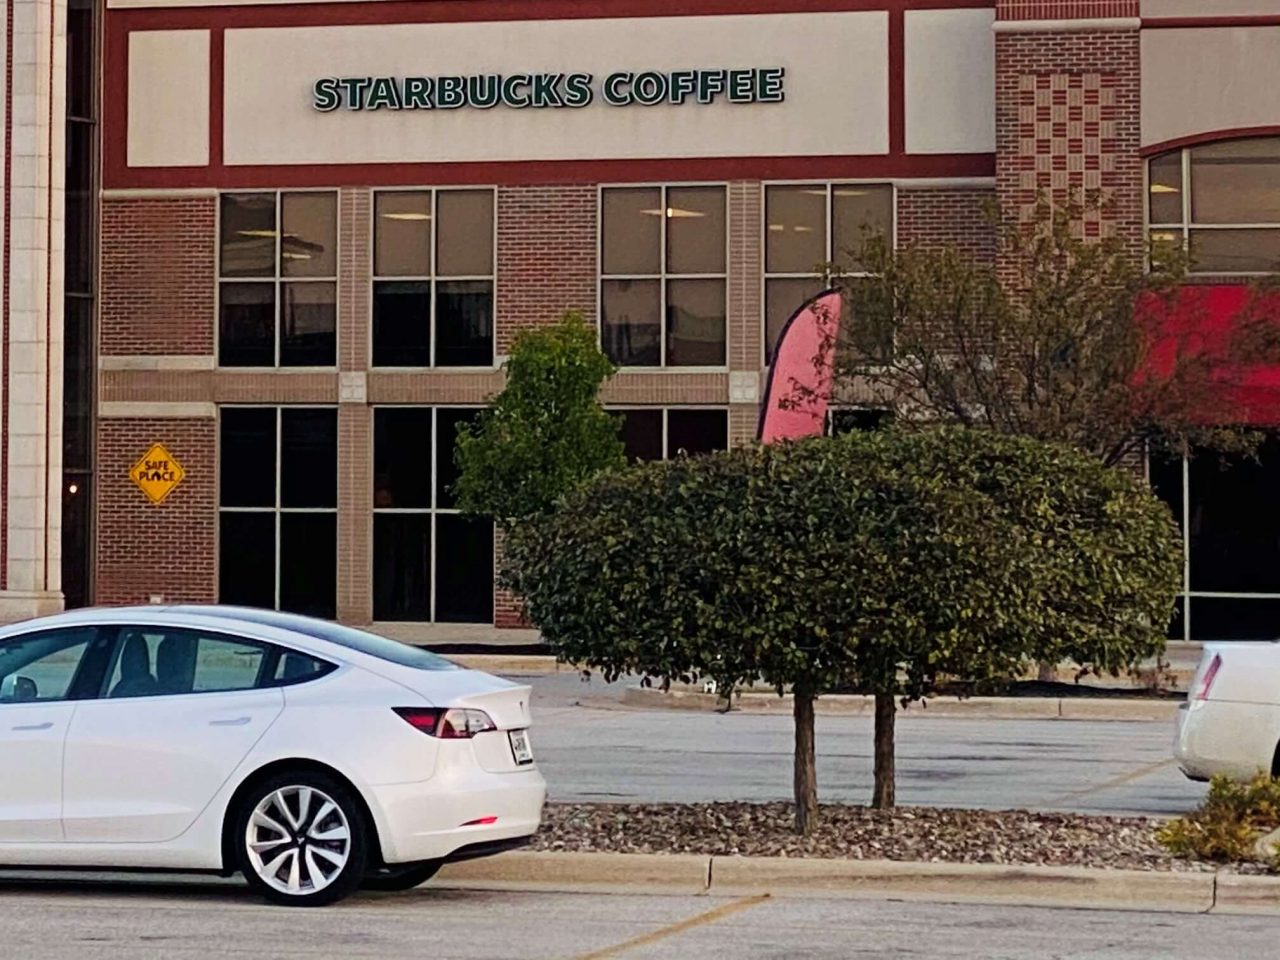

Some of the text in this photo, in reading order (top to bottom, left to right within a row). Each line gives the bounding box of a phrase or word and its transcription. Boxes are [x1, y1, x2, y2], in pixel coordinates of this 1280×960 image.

[313, 67, 786, 112] STARBUCKS COFFEE
[145, 460, 169, 470] SAFE
[139, 471, 174, 481] PLACE
